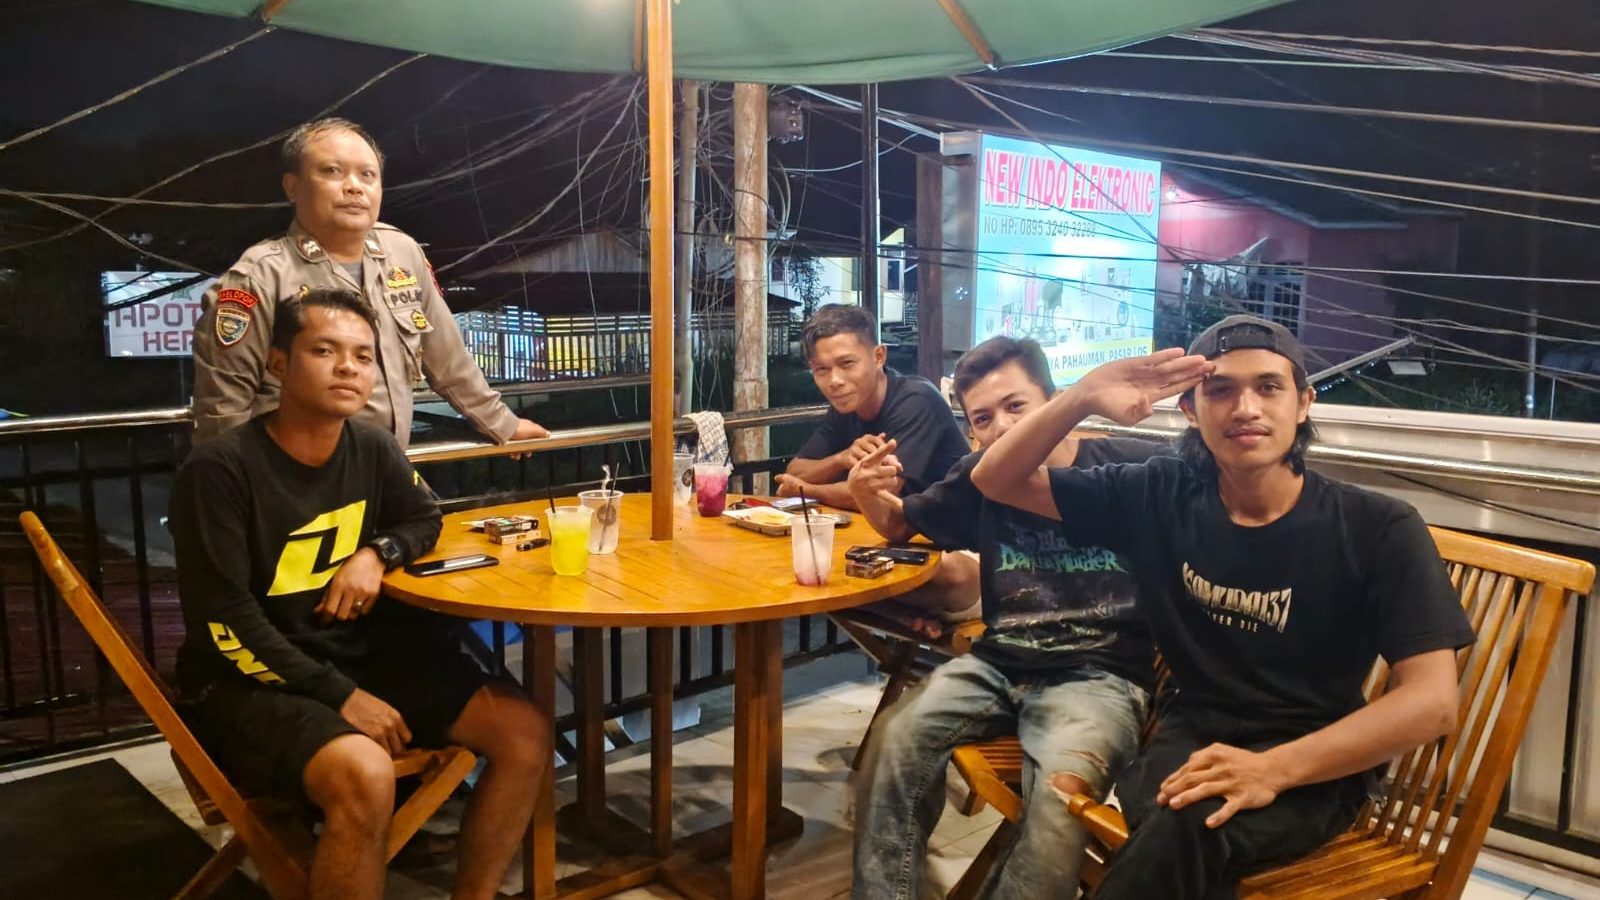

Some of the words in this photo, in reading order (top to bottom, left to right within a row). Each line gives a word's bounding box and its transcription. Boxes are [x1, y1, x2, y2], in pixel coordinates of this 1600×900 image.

[984, 150, 1026, 206] NEW
[1025, 156, 1069, 209] INDO
[1069, 161, 1157, 215] ELEKTRONIC
[984, 216, 998, 235] NO
[1001, 217, 1017, 235] HP:
[1020, 218, 1043, 236] 0895
[1240, 620, 1259, 632] DIE
